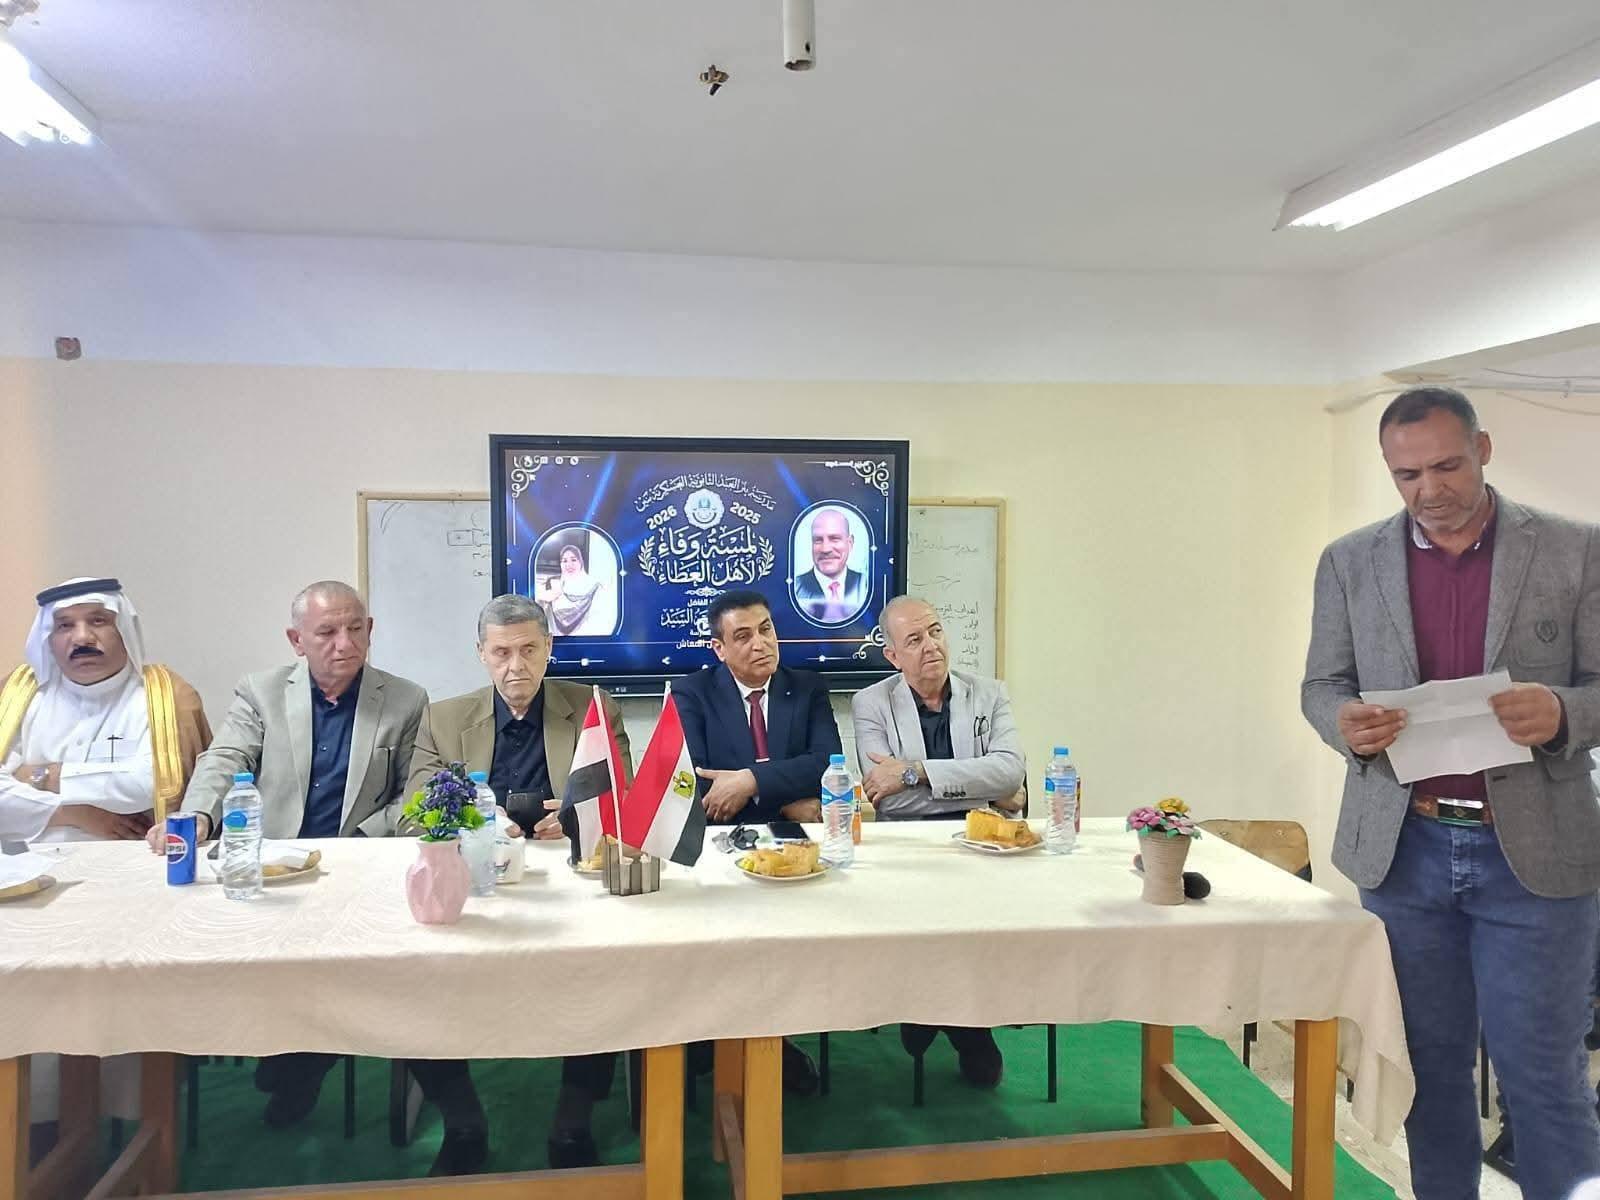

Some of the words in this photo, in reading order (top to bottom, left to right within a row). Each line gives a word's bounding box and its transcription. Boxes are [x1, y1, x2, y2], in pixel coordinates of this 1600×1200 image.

[652, 475, 688, 501] العسكرية
[688, 473, 717, 489] الثانوية
[748, 485, 777, 511] مدرسة
[646, 505, 678, 530] 2026
[730, 502, 762, 525] 2025
[657, 559, 710, 587] العطاء
